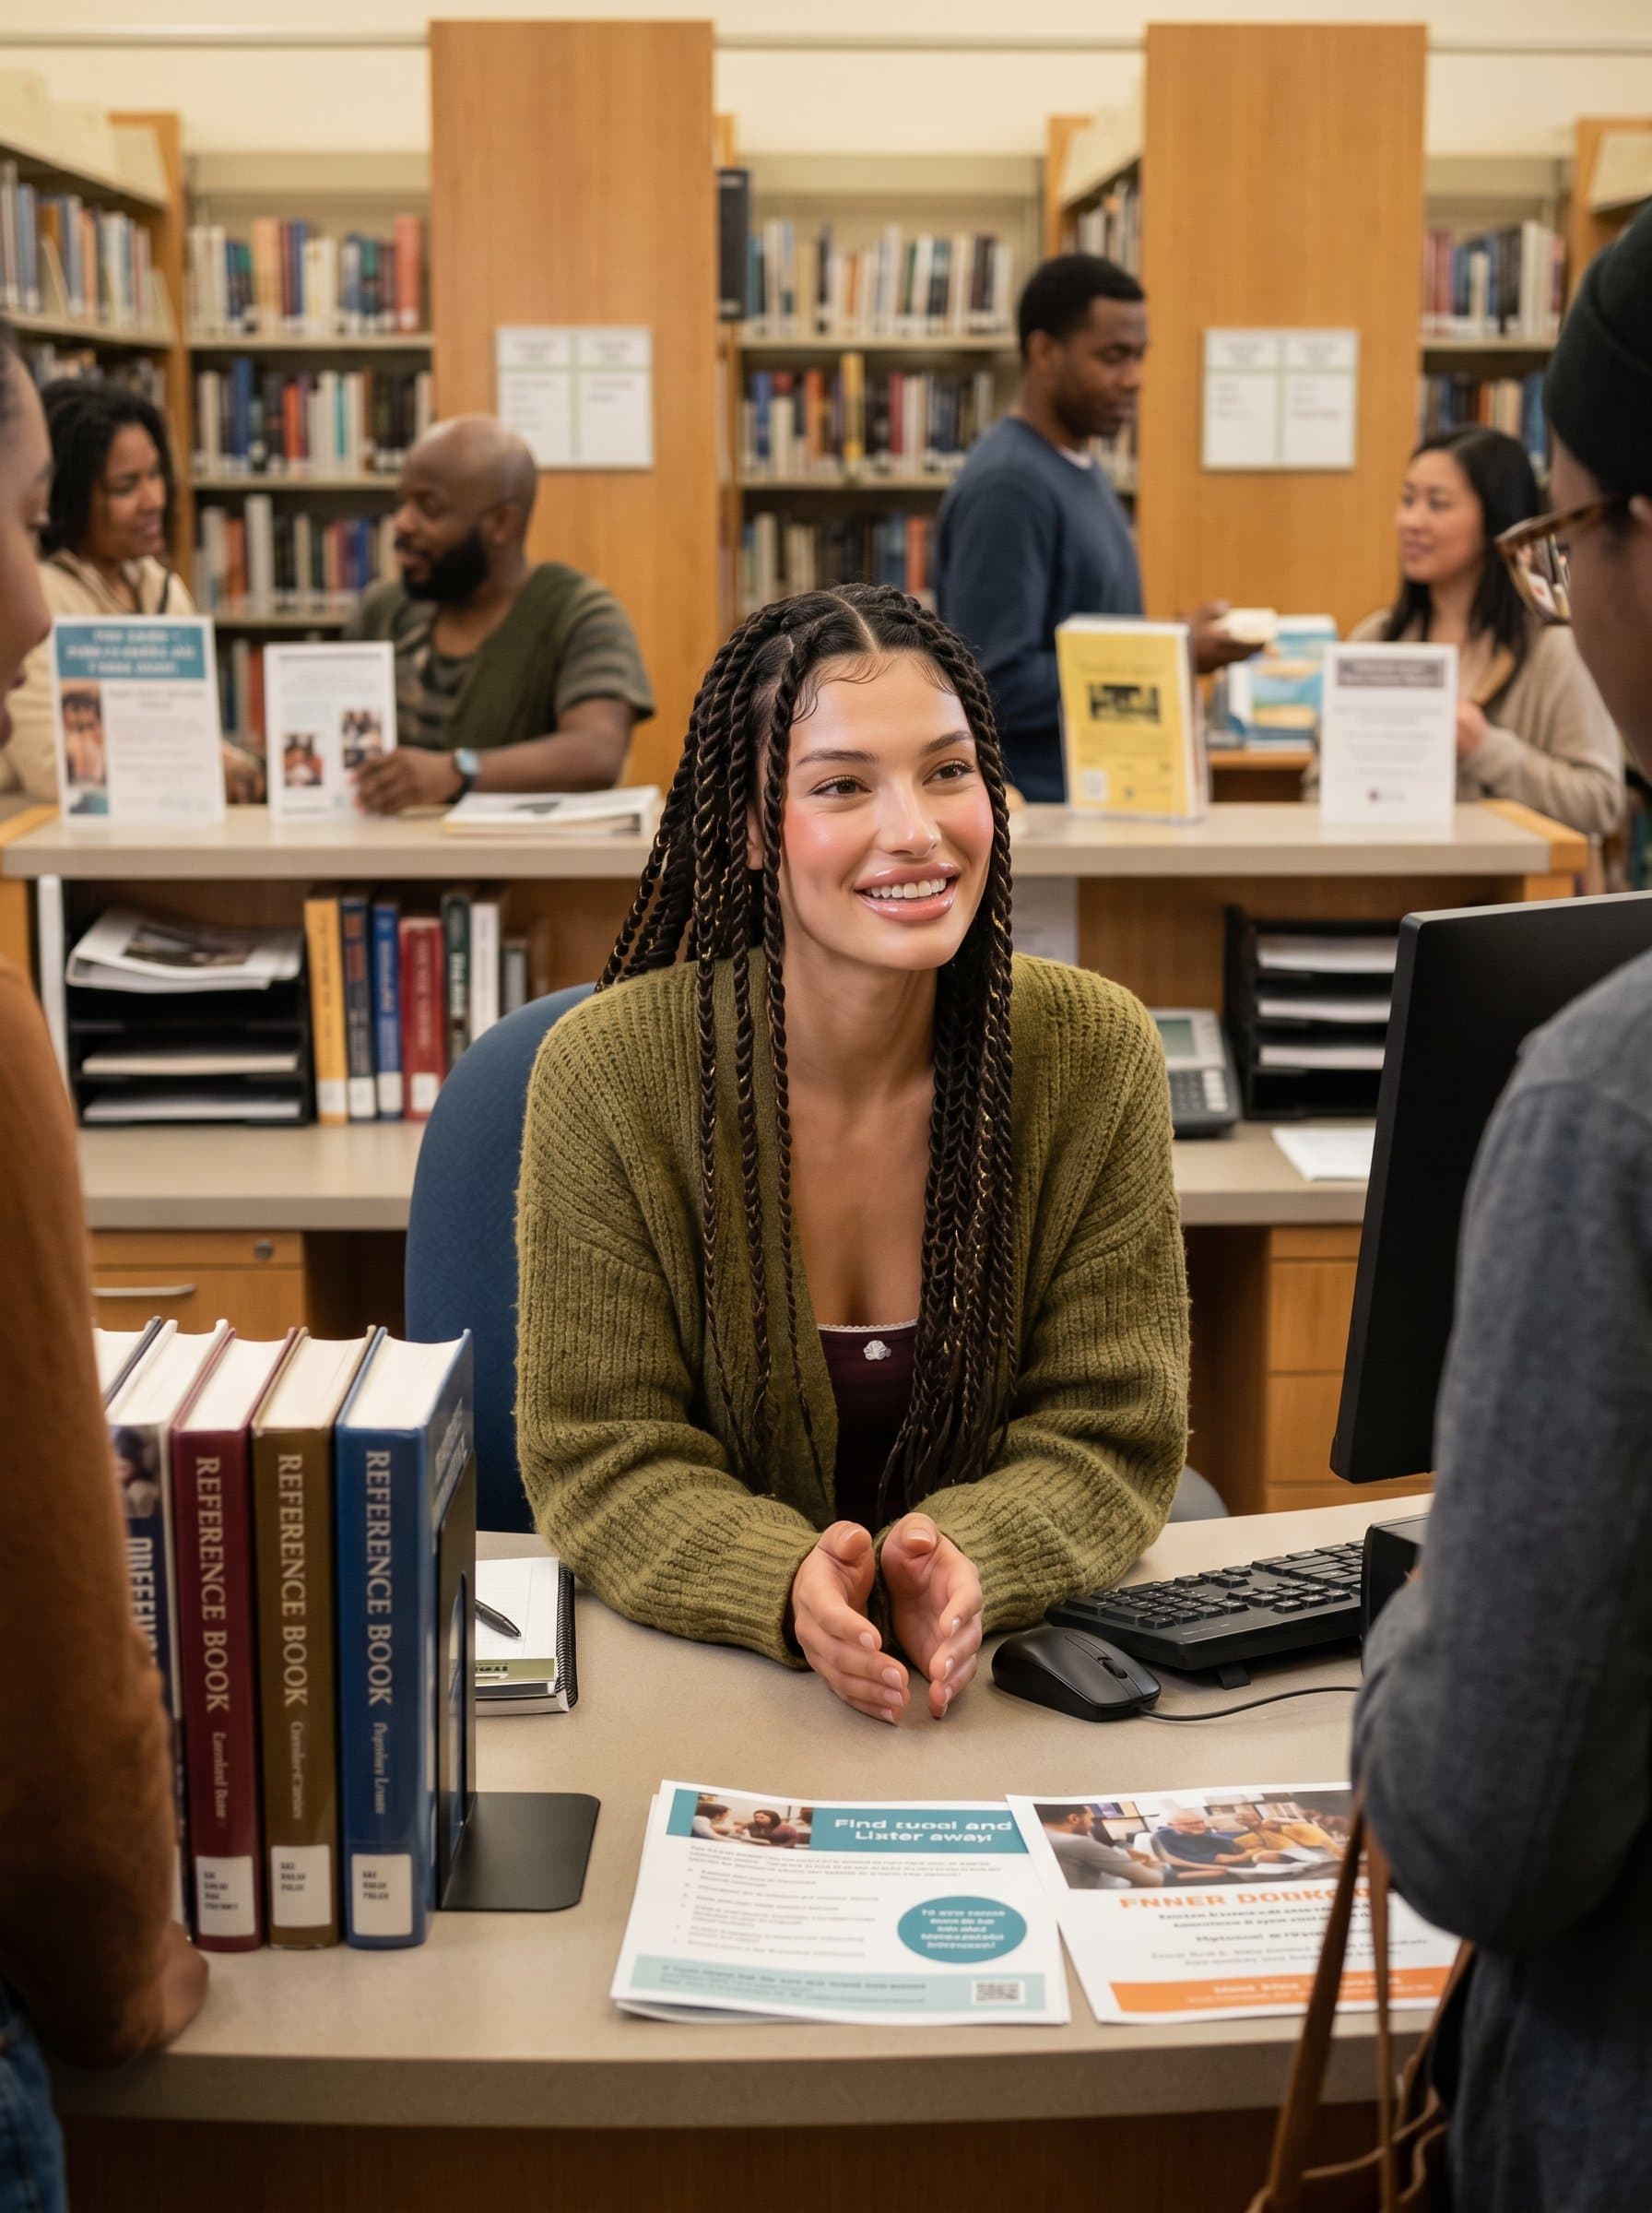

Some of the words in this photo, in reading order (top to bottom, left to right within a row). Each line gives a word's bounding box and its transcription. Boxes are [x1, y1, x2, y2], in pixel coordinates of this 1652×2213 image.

[195, 1457, 226, 1620] REFERENCE
[278, 1454, 306, 1615] REFERENCE
[366, 1450, 393, 1615] REFERENCE
[202, 1630, 230, 1712] BOOK
[282, 1625, 308, 1707] BOOK
[366, 1624, 393, 1706] BOOK
[965, 1821, 1012, 1831] and
